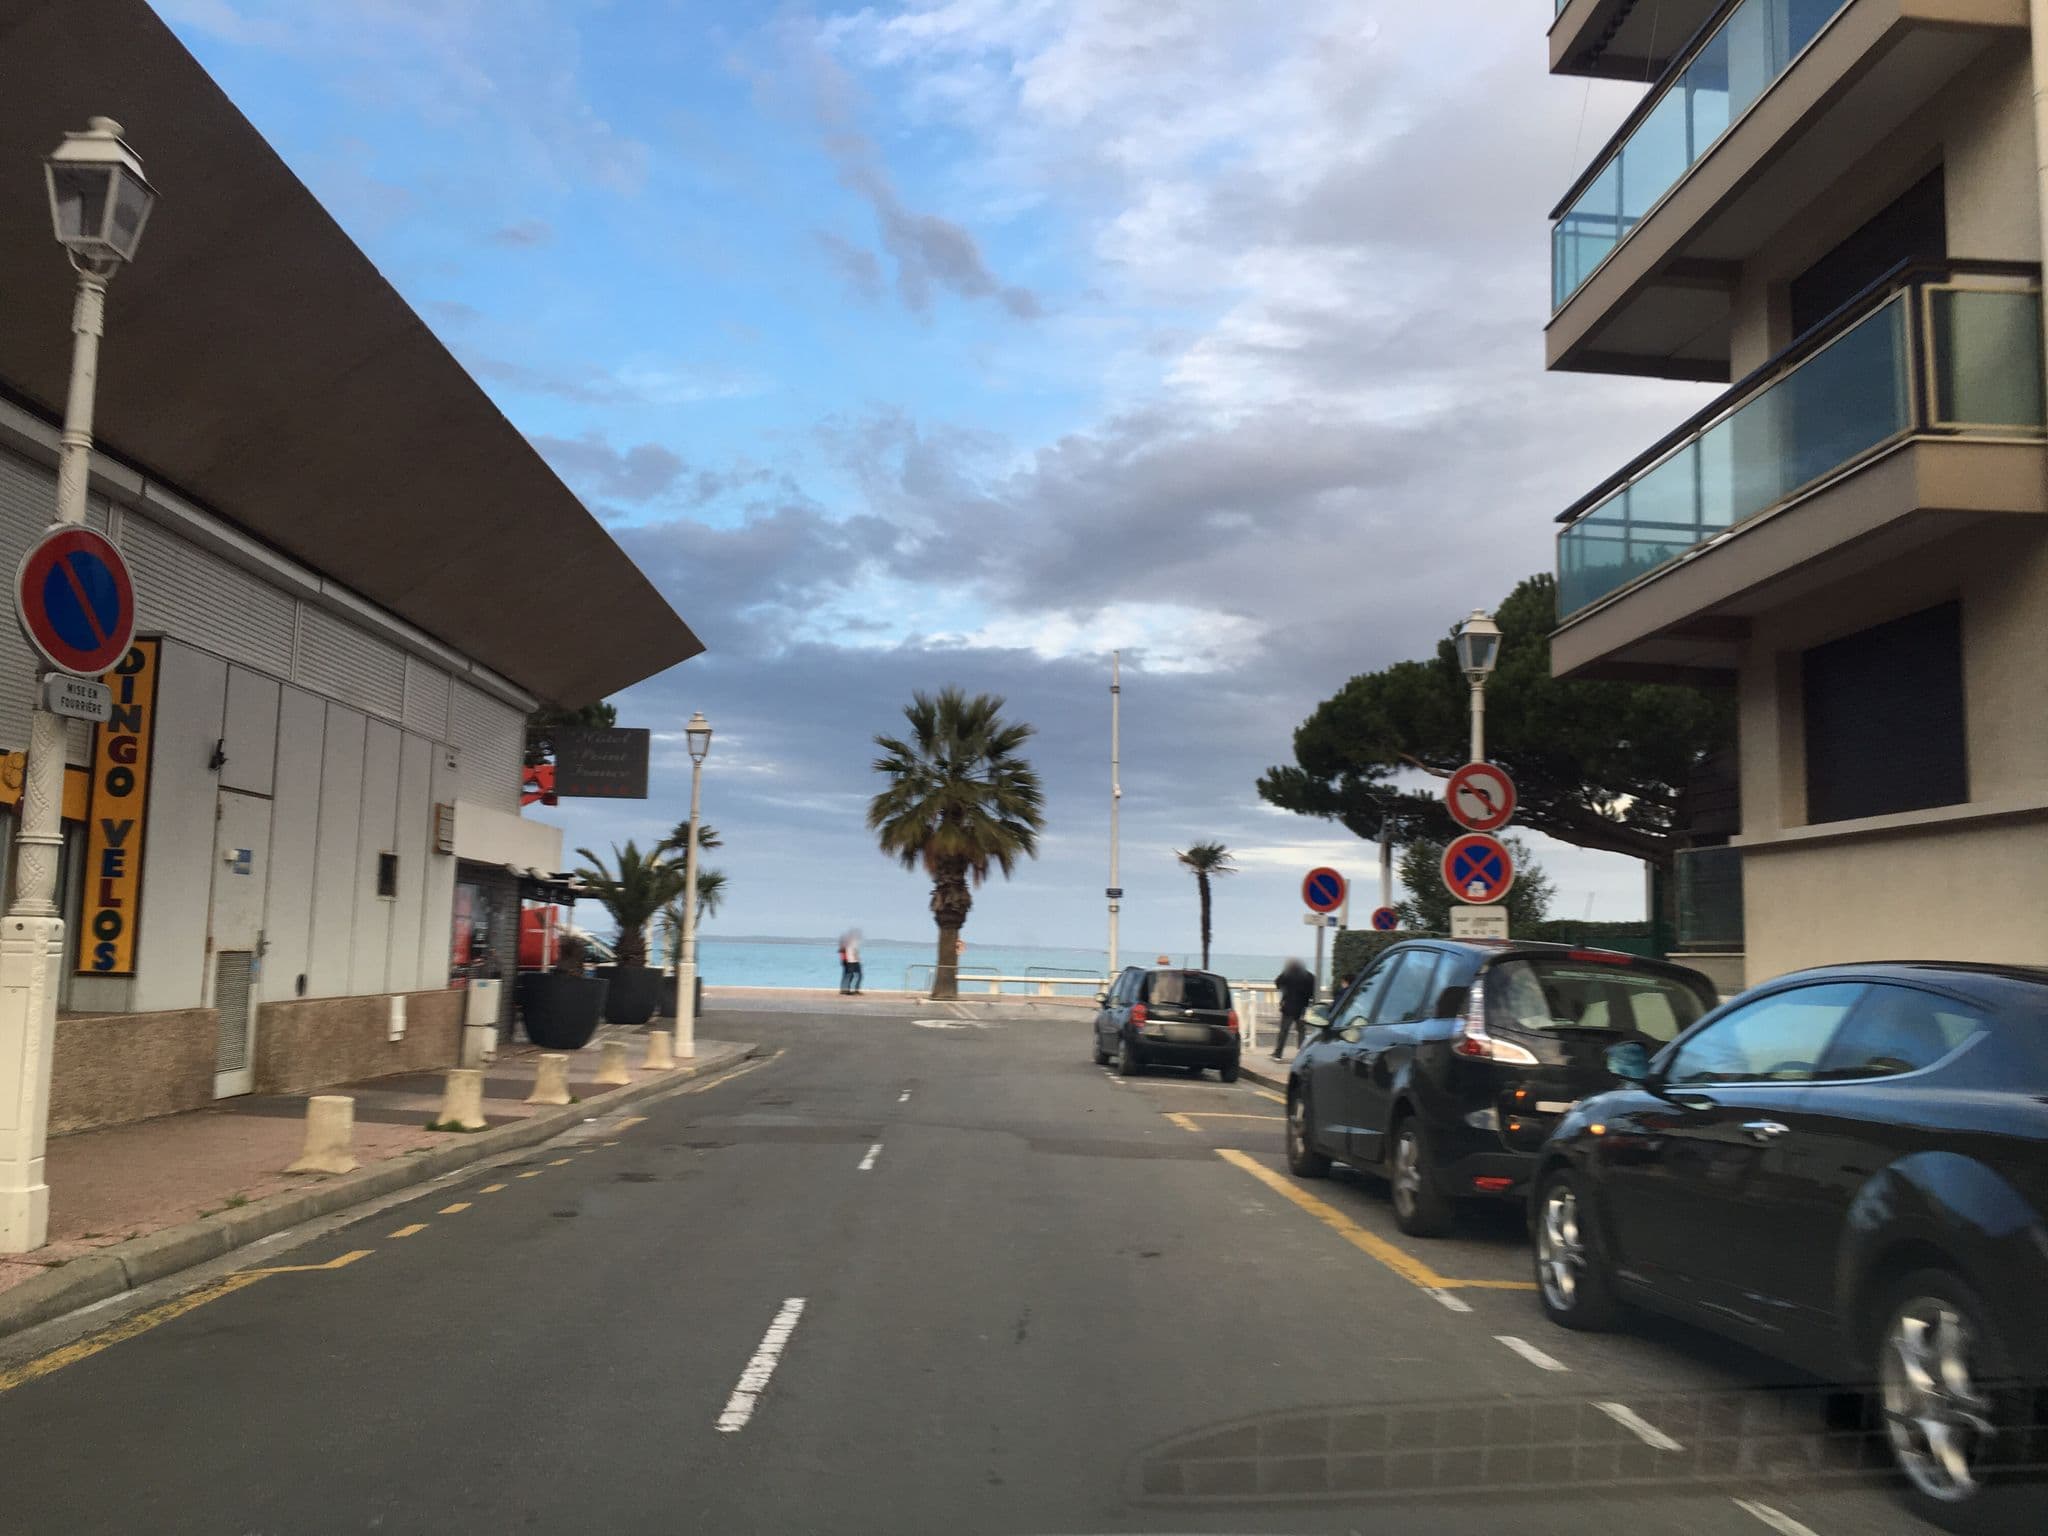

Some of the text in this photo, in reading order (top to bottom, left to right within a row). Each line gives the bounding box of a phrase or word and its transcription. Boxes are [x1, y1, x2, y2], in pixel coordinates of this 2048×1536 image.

[66, 682, 98, 699] MISE EN
[93, 647, 146, 971] DINGO VELOS
